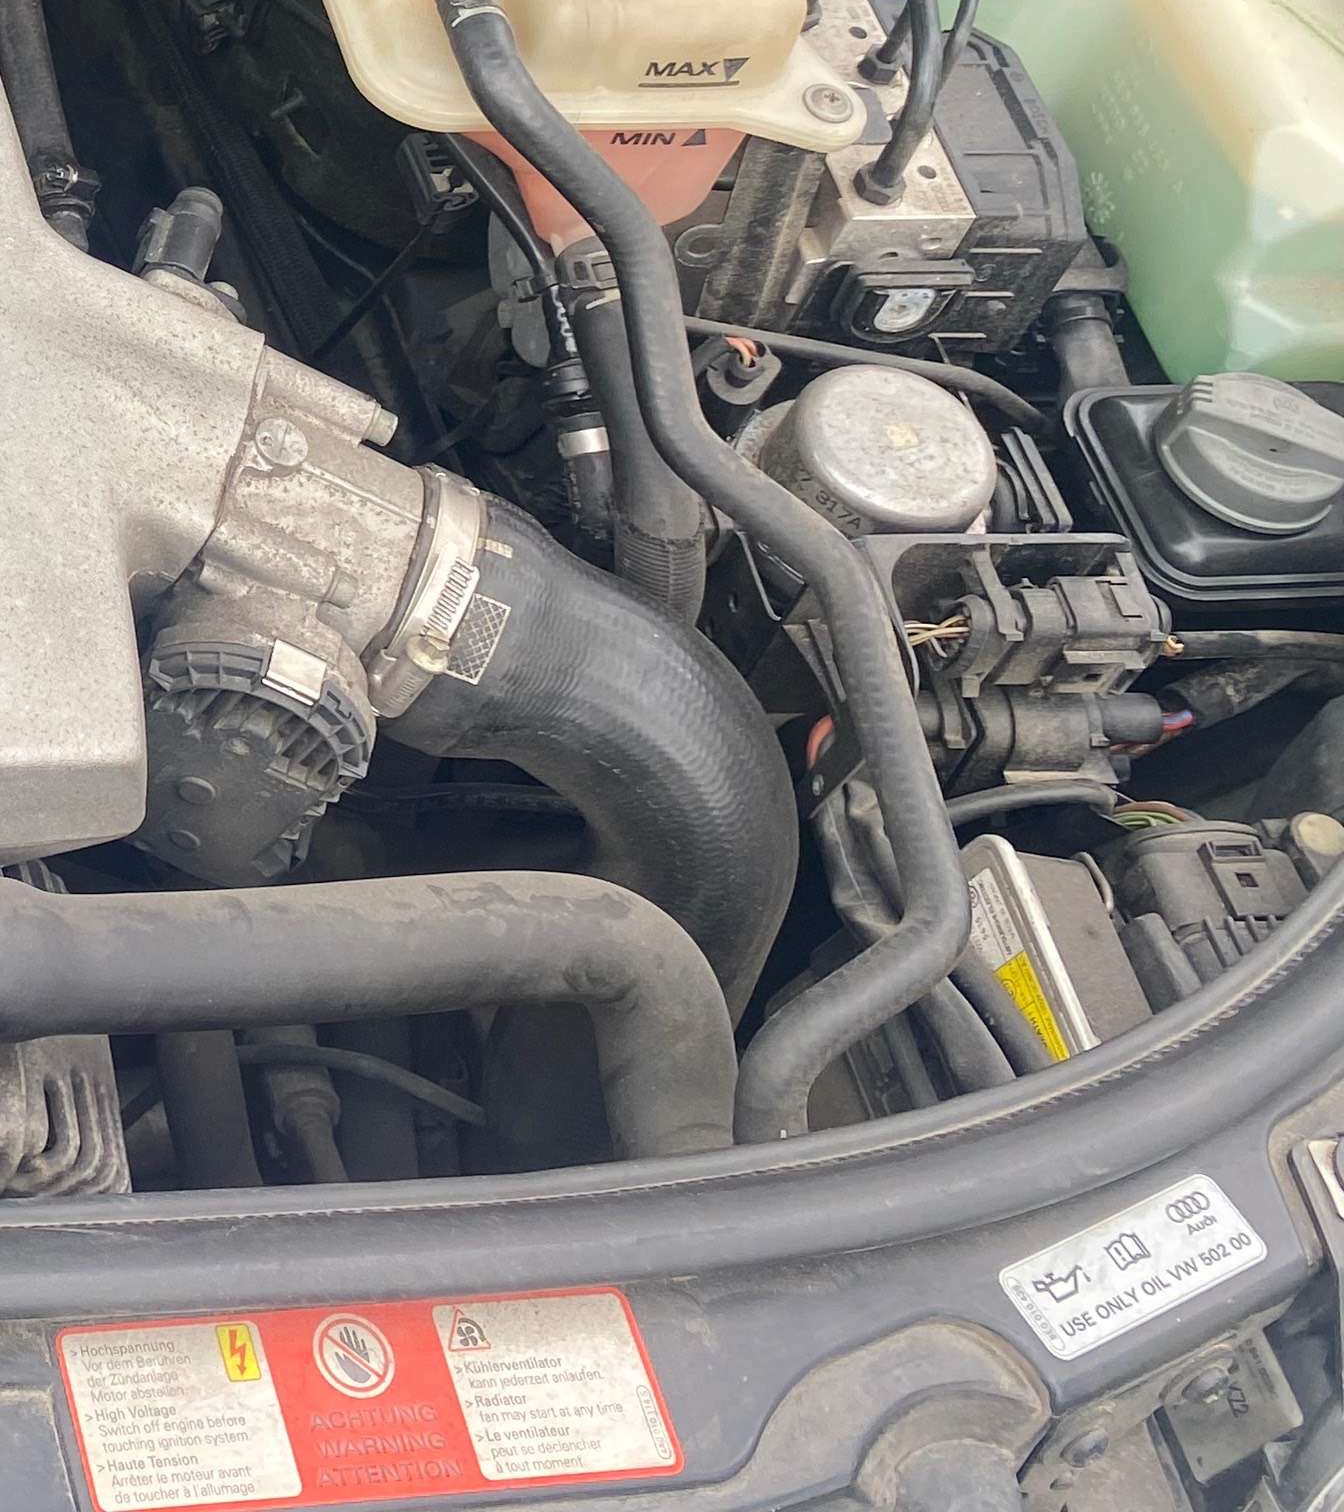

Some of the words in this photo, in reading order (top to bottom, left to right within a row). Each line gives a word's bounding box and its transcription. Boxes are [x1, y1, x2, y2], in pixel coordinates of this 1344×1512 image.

[645, 61, 720, 77] MAX
[610, 133, 676, 145] MIN
[1186, 1215, 1217, 1236] Audi
[1060, 1312, 1096, 1338] USE
[1095, 1289, 1141, 1320] ONLY
[1140, 1272, 1172, 1296] OIL
[1166, 1257, 1199, 1282] VW
[1199, 1243, 1231, 1267] 502
[1230, 1232, 1252, 1248] 00
[80, 1340, 176, 1357] Hochspannung
[106, 1357, 134, 1371] dem
[463, 1356, 563, 1375] Kühlerventilator
[87, 1375, 106, 1389] der
[469, 1375, 497, 1389] kann
[500, 1373, 550, 1390] jederzeit
[91, 1389, 128, 1402] Motor
[475, 1394, 527, 1408] Radiator
[95, 1409, 125, 1424] High
[129, 1405, 177, 1420] Voltage
[310, 1404, 438, 1432] ACHTUNG
[479, 1410, 499, 1423] fan
[502, 1410, 528, 1424] may
[530, 1406, 556, 1420] start
[560, 1406, 572, 1418] at
[574, 1405, 594, 1419] any
[597, 1401, 624, 1414] time
[98, 1422, 140, 1437] Switch
[144, 1420, 160, 1433] off
[164, 1418, 204, 1435] engine
[208, 1414, 247, 1428] before
[485, 1430, 501, 1443] Le
[504, 1425, 571, 1441] ventilateur
[102, 1437, 156, 1454] touching
[158, 1434, 202, 1451] ignition
[204, 1430, 249, 1446] system
[317, 1431, 447, 1459] WARNING
[490, 1445, 518, 1459] peut
[521, 1444, 535, 1456] se
[107, 1458, 146, 1473] Haute
[150, 1453, 199, 1469] Tension
[496, 1460, 504, 1474] à
[506, 1459, 531, 1473] tout
[533, 1456, 584, 1471] moment
[111, 1472, 153, 1487] Arrêter
[156, 1471, 168, 1484] le
[170, 1468, 215, 1483] moteur
[218, 1465, 252, 1479] avant
[318, 1460, 463, 1488] ATTENTION
[115, 1490, 131, 1504] de
[133, 1487, 180, 1503] toucher
[183, 1485, 191, 1498] à
